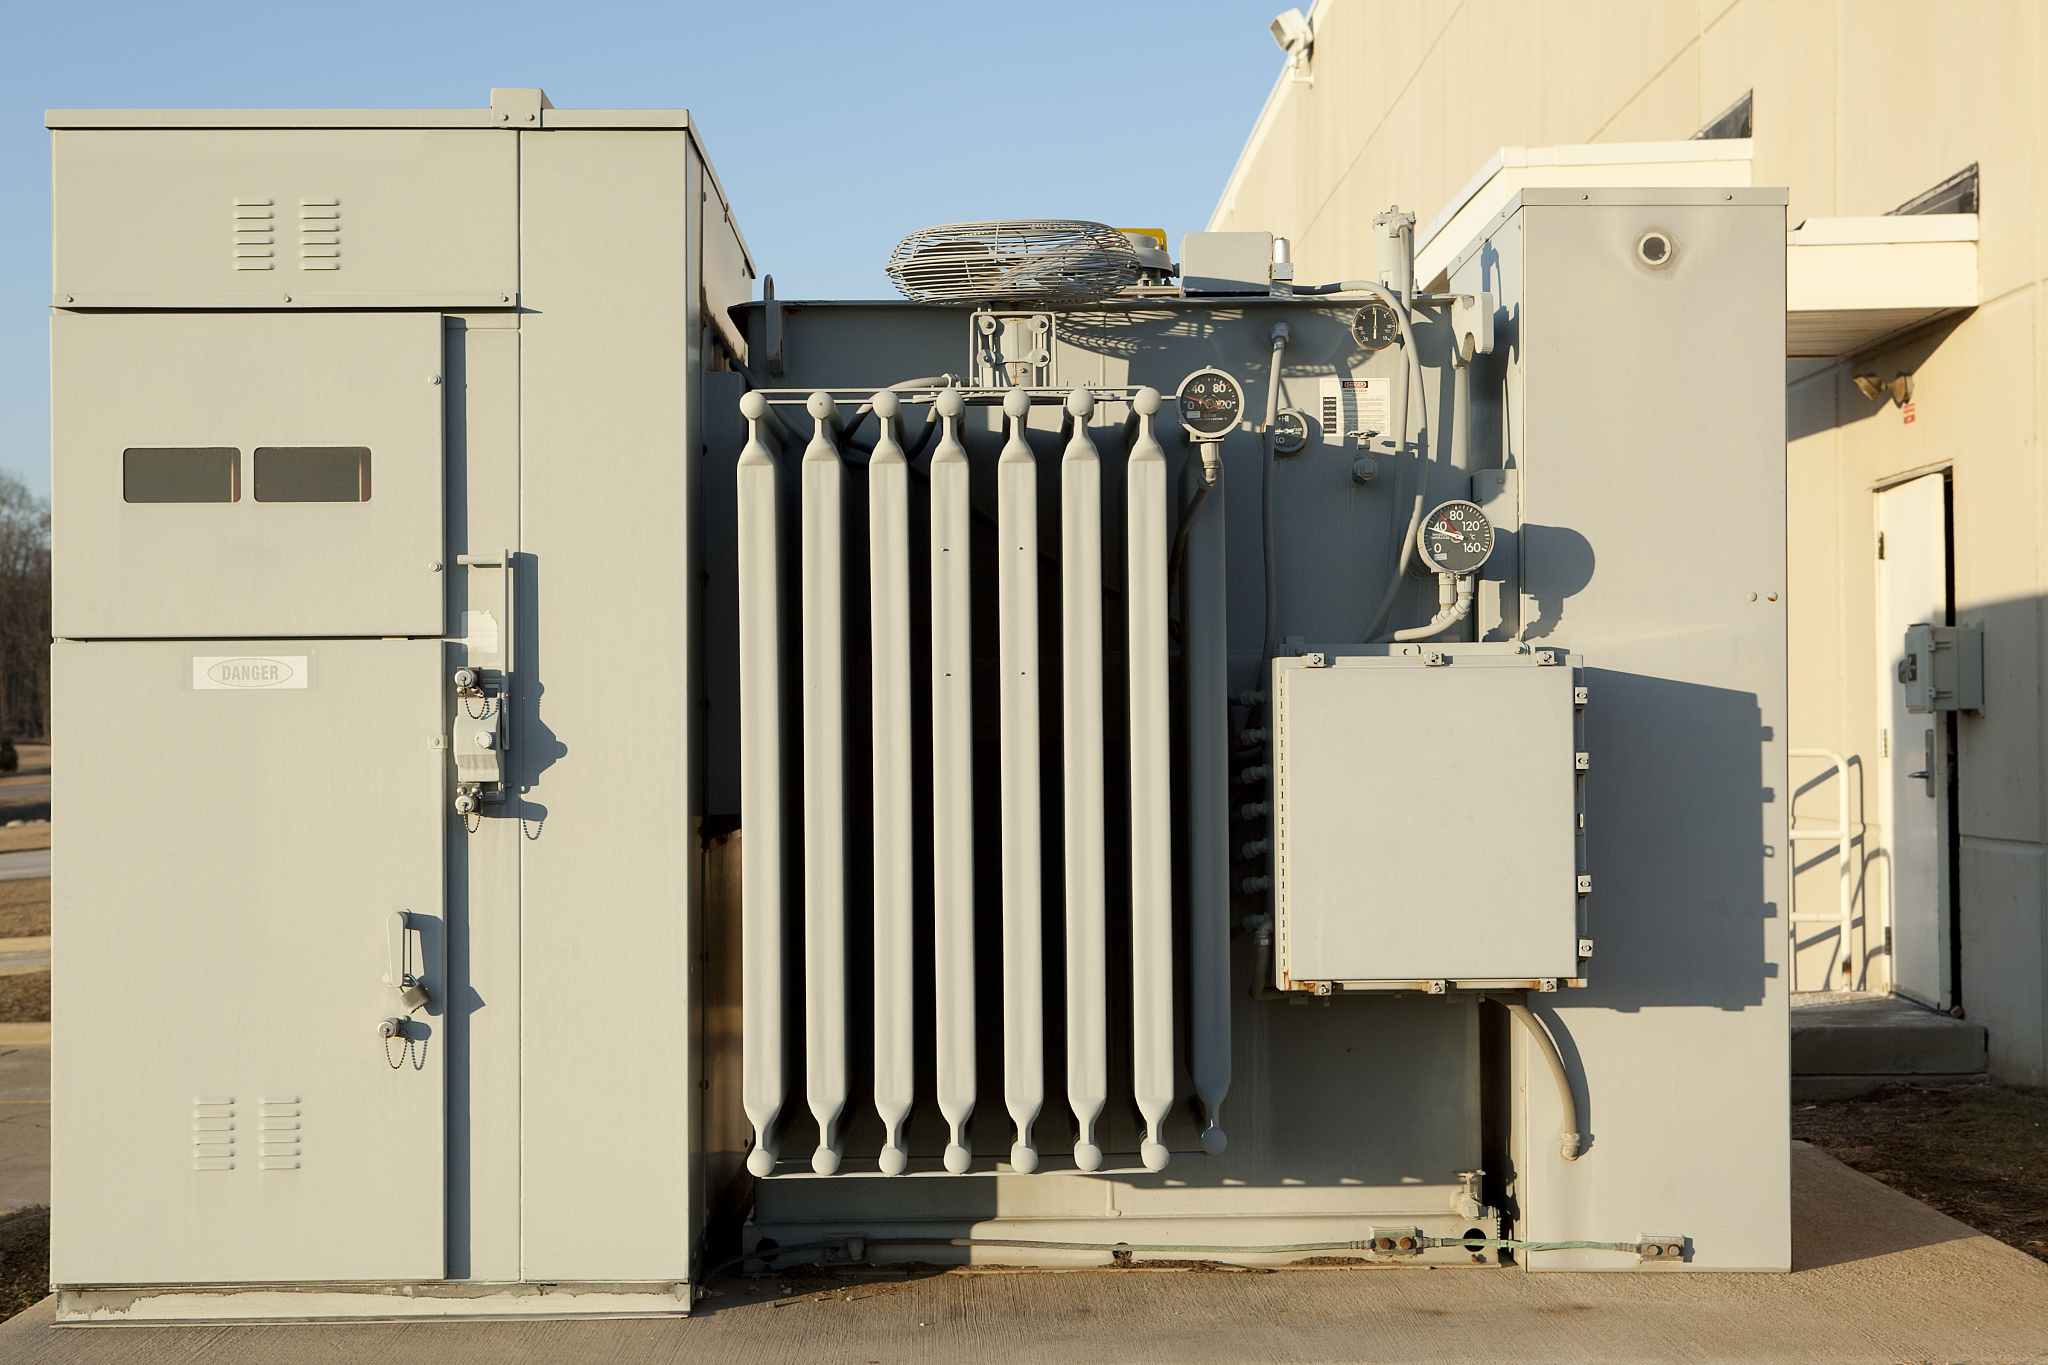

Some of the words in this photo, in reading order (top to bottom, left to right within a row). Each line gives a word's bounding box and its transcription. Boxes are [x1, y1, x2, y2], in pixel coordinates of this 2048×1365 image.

[1191, 384, 1205, 394] 40
[1212, 383, 1226, 393] 80
[1187, 401, 1195, 410] 0
[1275, 436, 1285, 444] LO
[1449, 510, 1464, 521] 80
[1433, 521, 1448, 532] 40
[1461, 520, 1480, 531] 120
[1434, 543, 1442, 553] 0
[1462, 542, 1481, 553] 160
[222, 665, 279, 681] DANGER
